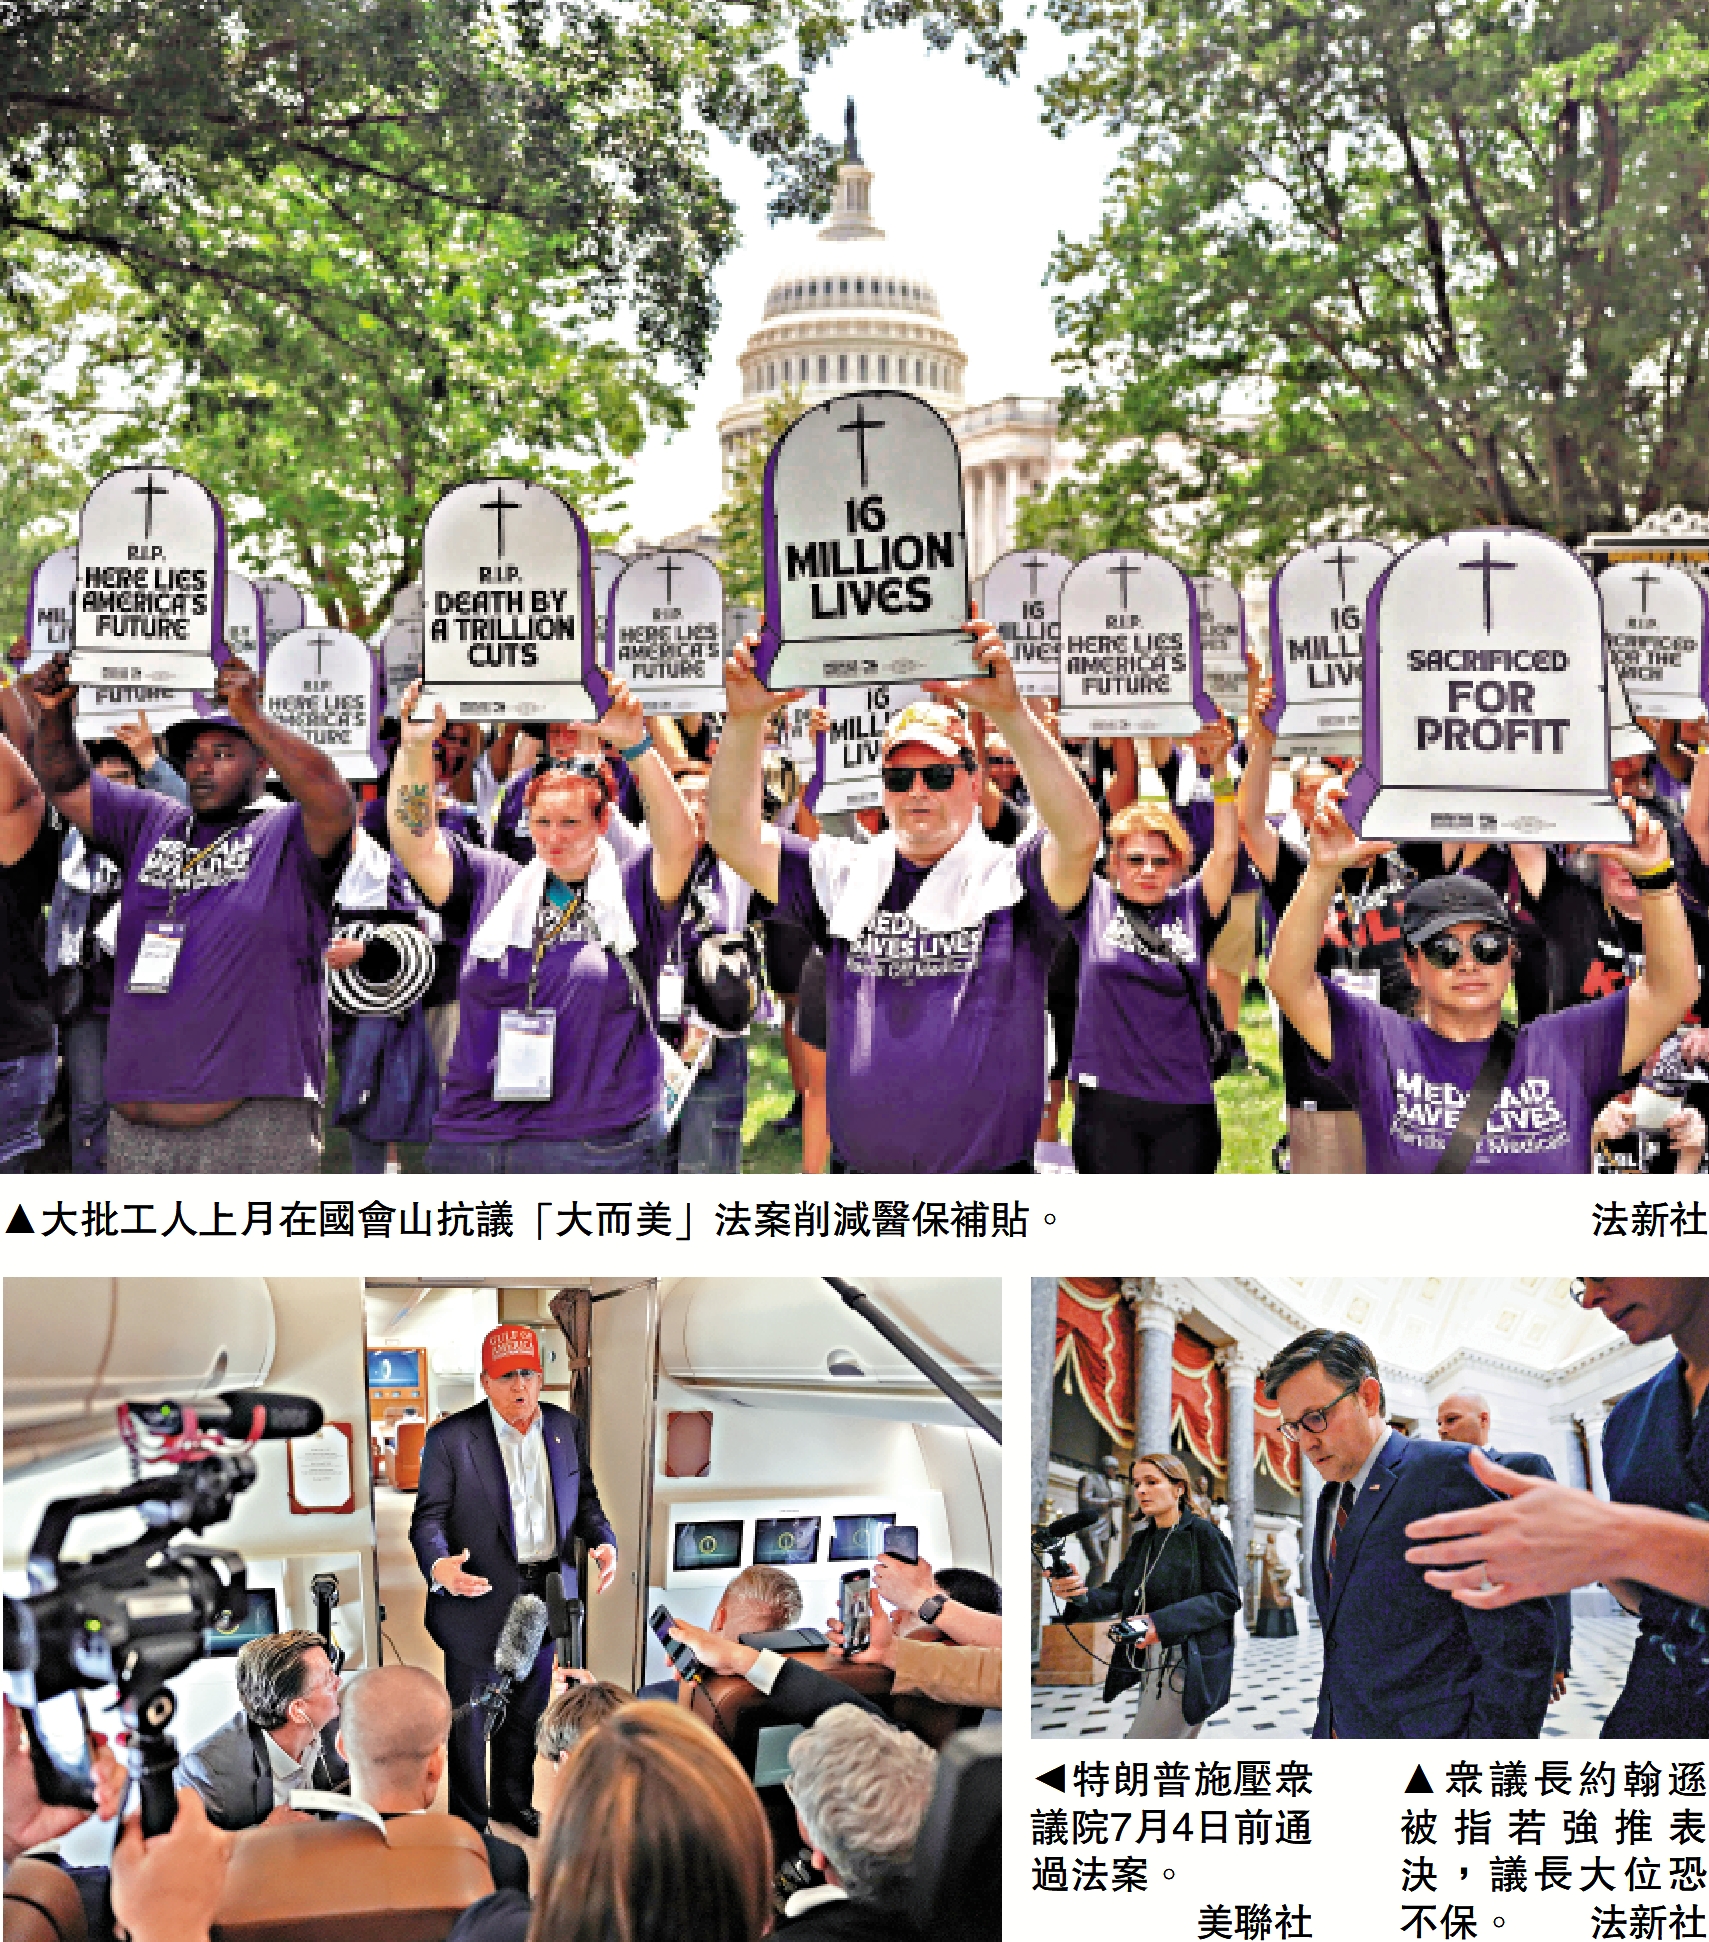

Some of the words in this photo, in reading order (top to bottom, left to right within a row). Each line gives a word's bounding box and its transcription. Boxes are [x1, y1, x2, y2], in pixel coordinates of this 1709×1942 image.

[844, 495, 887, 532] 16
[786, 532, 954, 581] MILLION
[85, 567, 148, 589] HERE
[155, 567, 207, 591] LIES
[83, 591, 207, 615] AMERICA'S
[434, 590, 522, 615] DEATH
[531, 590, 568, 613] BY
[810, 576, 933, 619] LIVES
[96, 615, 190, 640] FUTURE
[431, 618, 448, 641] A
[454, 615, 575, 641] TRILLION
[1331, 605, 1359, 633] 16
[619, 626, 671, 643] HERE
[1067, 634, 1128, 653] HERE
[1132, 632, 1183, 651] LIES
[467, 643, 537, 668] CUTS
[1067, 653, 1186, 676] AMERICA'S
[1407, 650, 1570, 673] SACRIFICED
[633, 660, 705, 680] FUTURE
[1082, 673, 1170, 695] FUTURE
[1448, 680, 1536, 715] FOR
[1416, 716, 1571, 754] PROFIT
[844, 740, 881, 768] LIV
